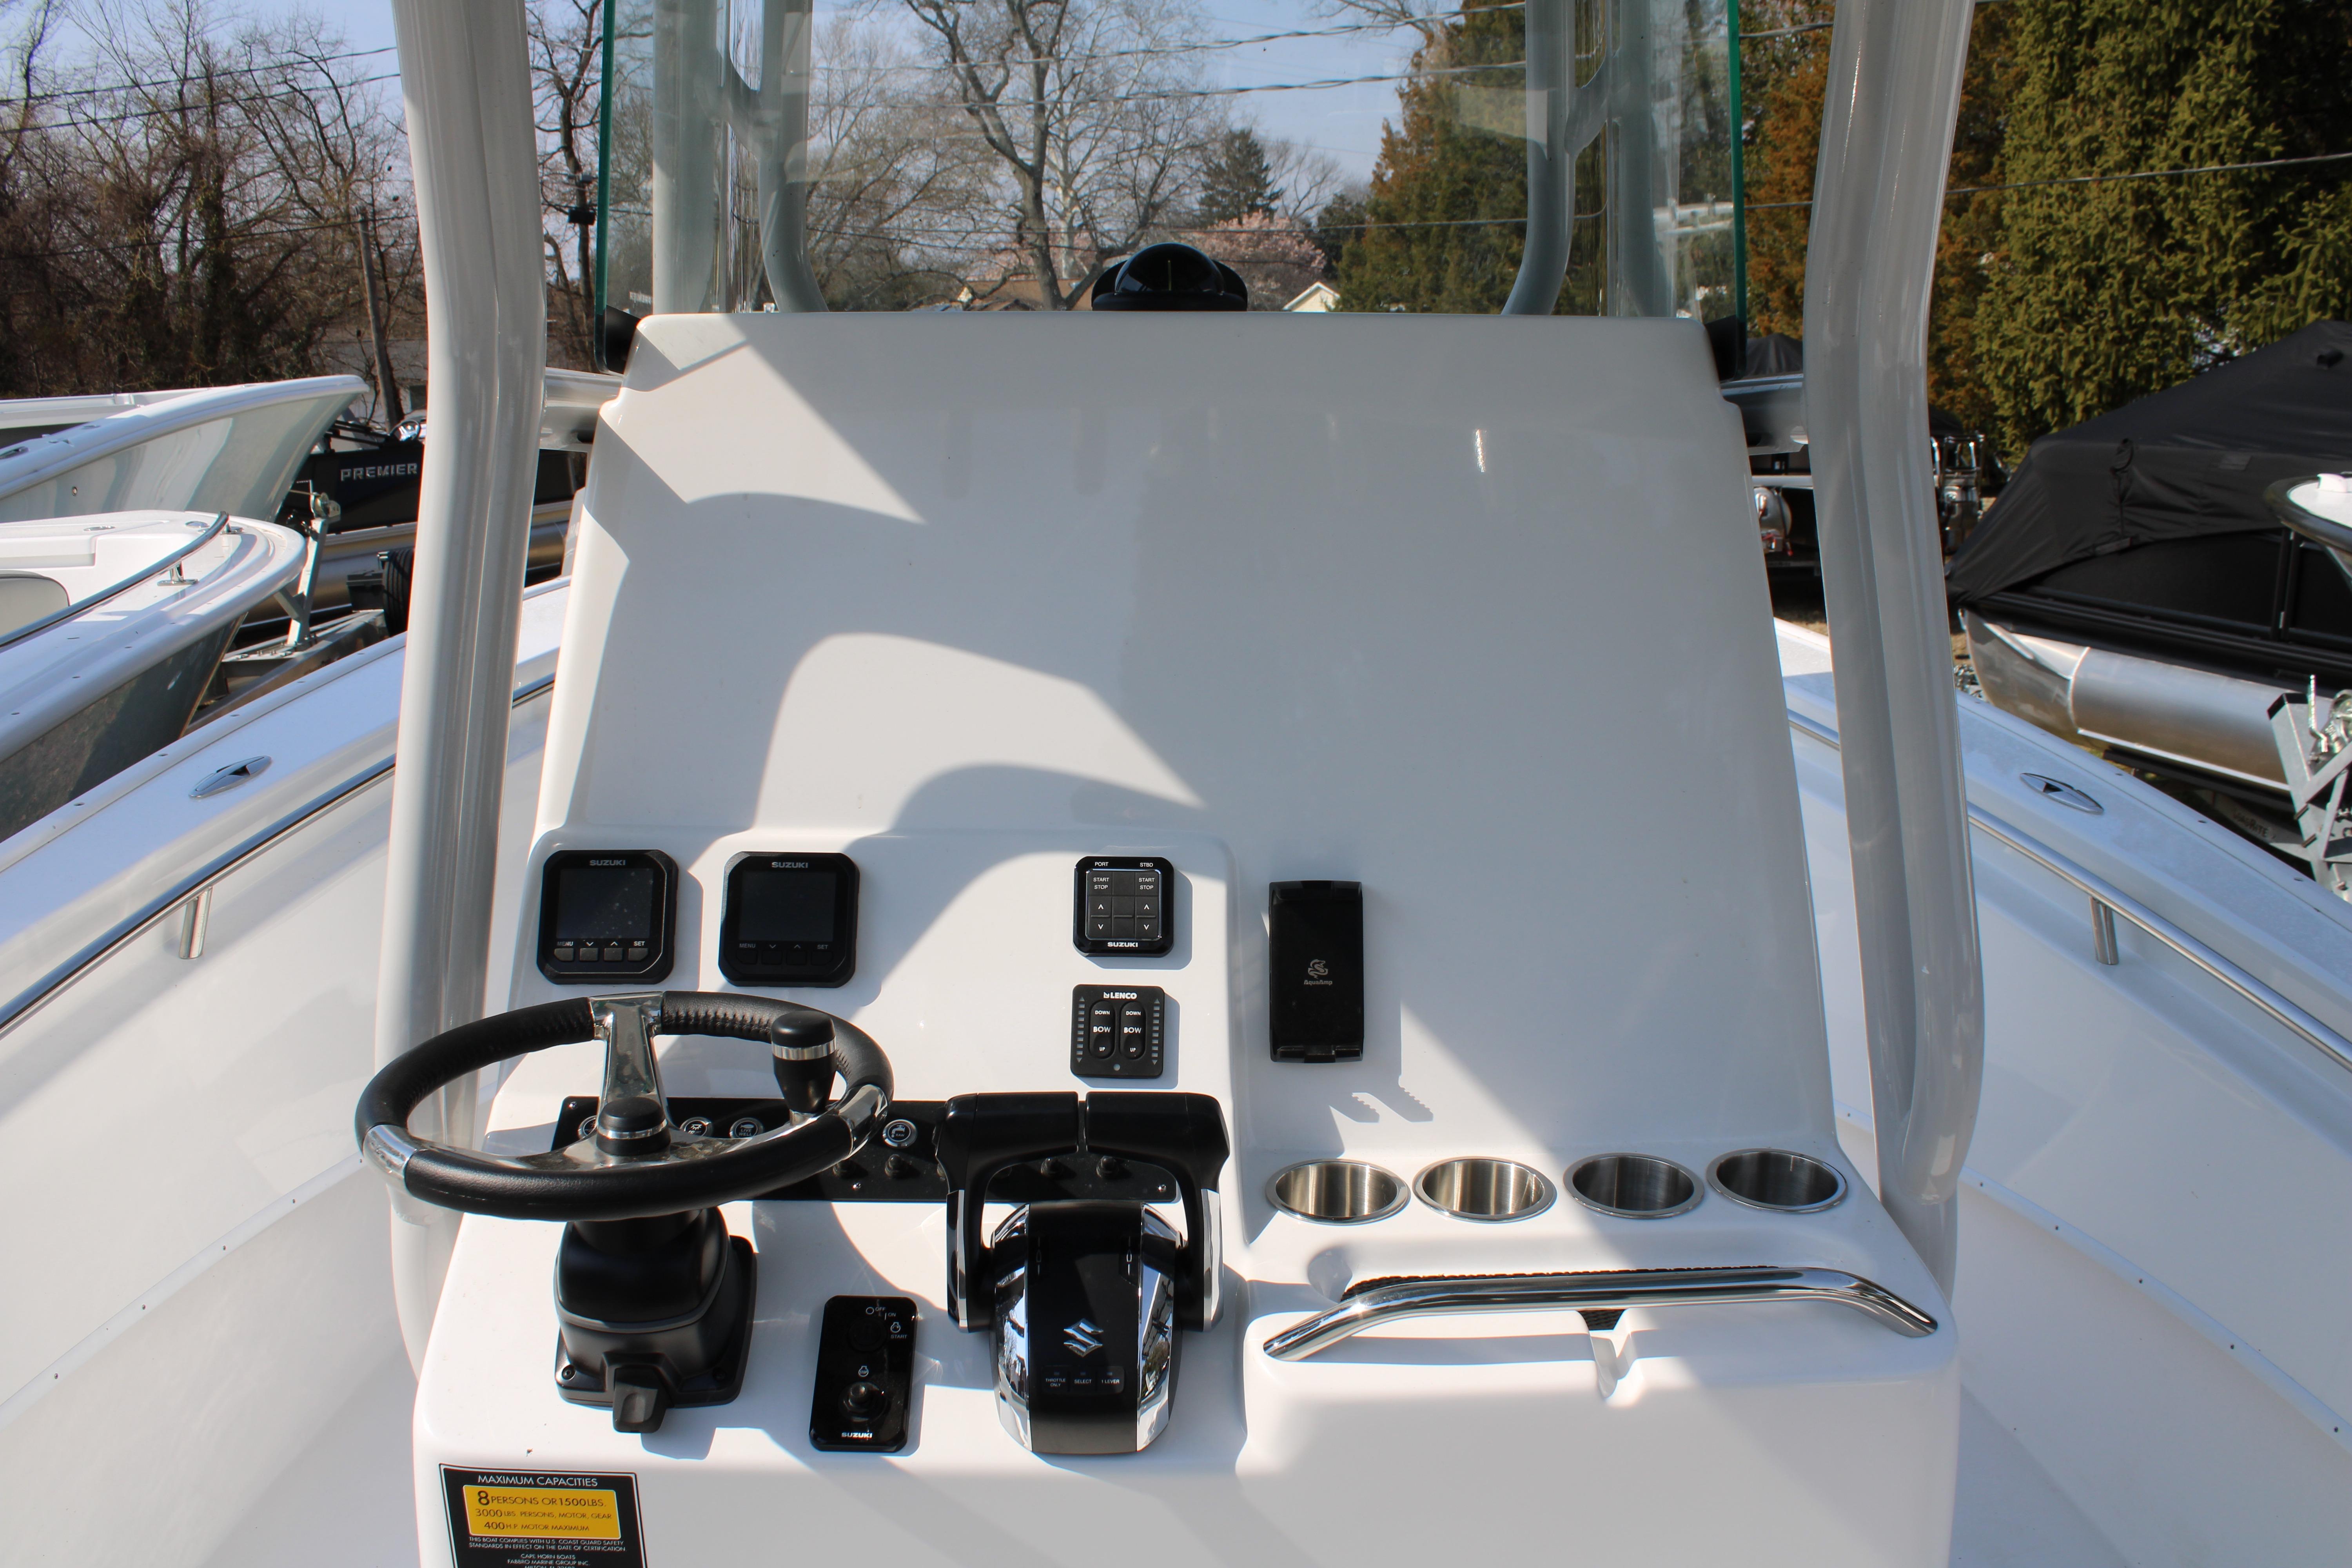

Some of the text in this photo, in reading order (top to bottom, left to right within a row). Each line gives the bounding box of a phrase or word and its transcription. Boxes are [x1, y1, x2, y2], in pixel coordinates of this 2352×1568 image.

[341, 463, 417, 481] PREMIER
[478, 1474, 598, 1486] MAXIMUM CAPACITIES
[477, 1490, 606, 1507] 8 PERSONS OR 1500 LBS.
[475, 1508, 502, 1517] 3000
[484, 1521, 505, 1530] 400
